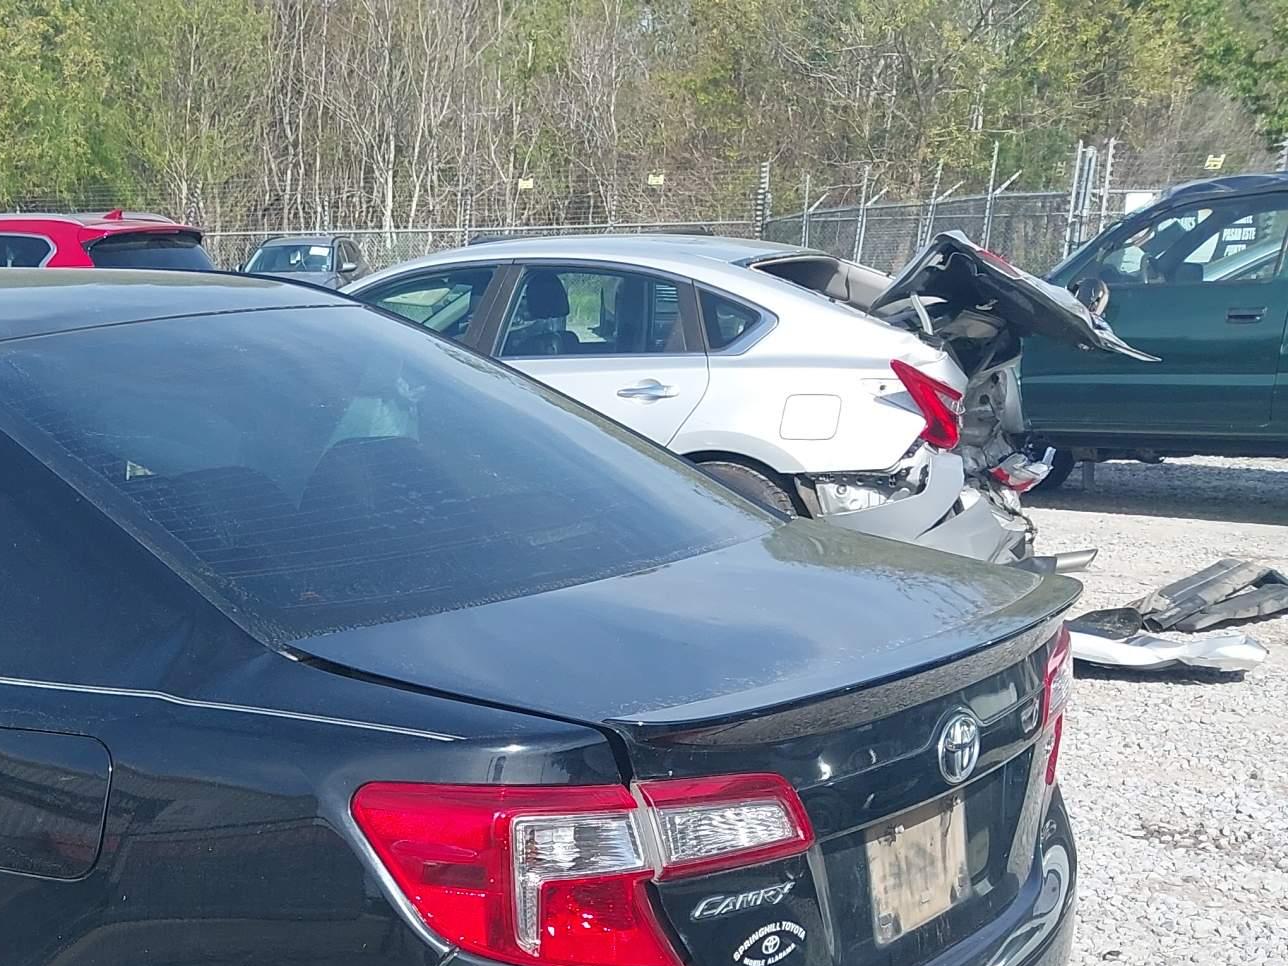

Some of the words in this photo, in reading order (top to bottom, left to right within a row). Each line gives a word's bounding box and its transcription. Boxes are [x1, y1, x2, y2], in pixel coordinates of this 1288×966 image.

[691, 881, 796, 920] CAMRY
[733, 922, 781, 962] SPRINGHILL
[781, 921, 806, 941] TOYOTA
[743, 957, 766, 966] MOBILE
[767, 942, 796, 965] ALABAMA
